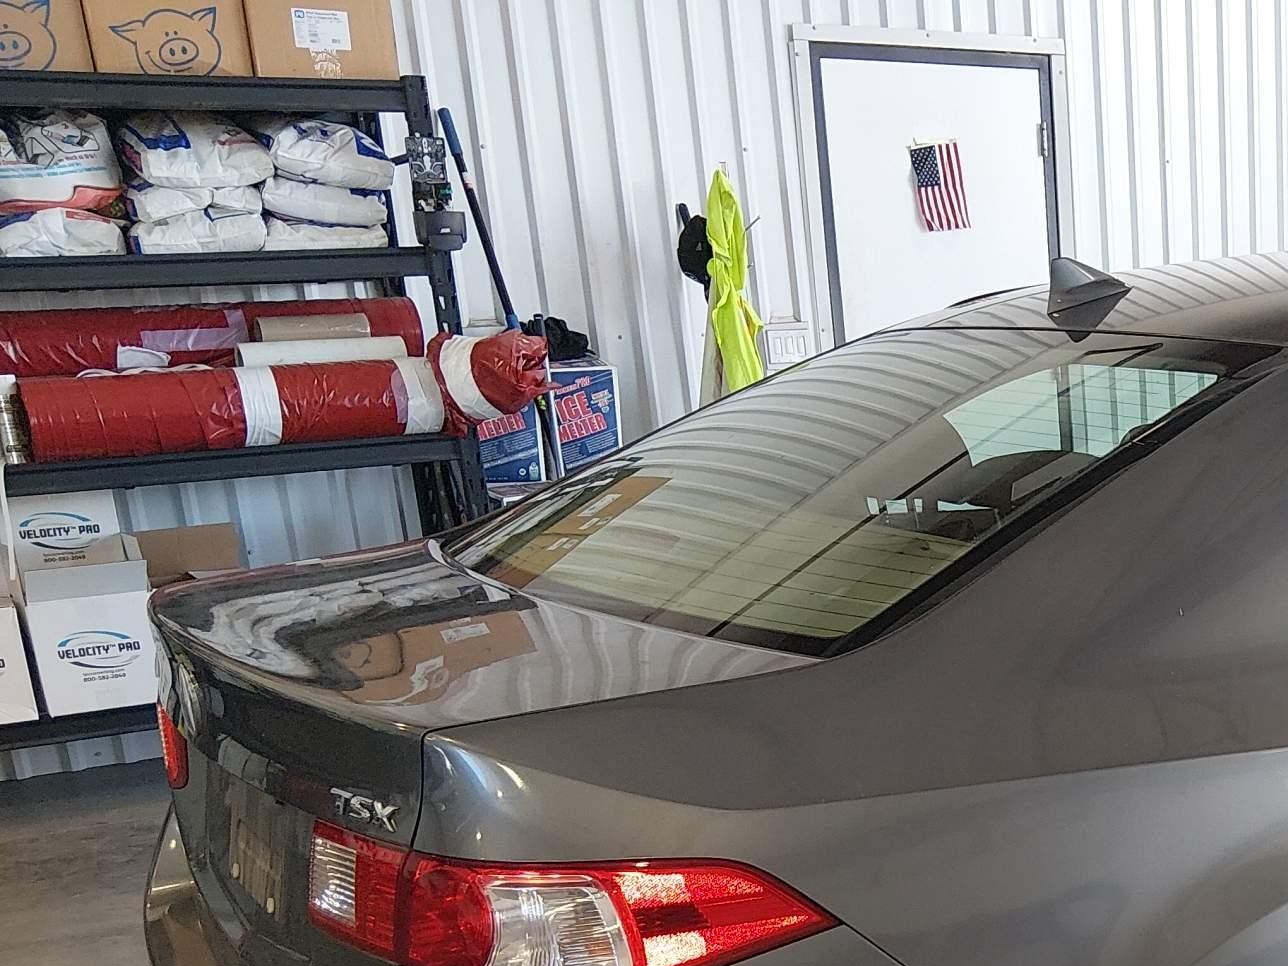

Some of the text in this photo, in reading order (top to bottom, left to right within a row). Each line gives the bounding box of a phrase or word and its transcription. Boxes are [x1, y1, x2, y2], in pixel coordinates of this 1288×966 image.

[554, 390, 593, 424] ICE
[477, 410, 527, 441] MELTER
[557, 412, 608, 443] MELTER
[78, 523, 100, 535] PRO
[118, 640, 141, 653] PRO
[330, 787, 401, 833] TSX
